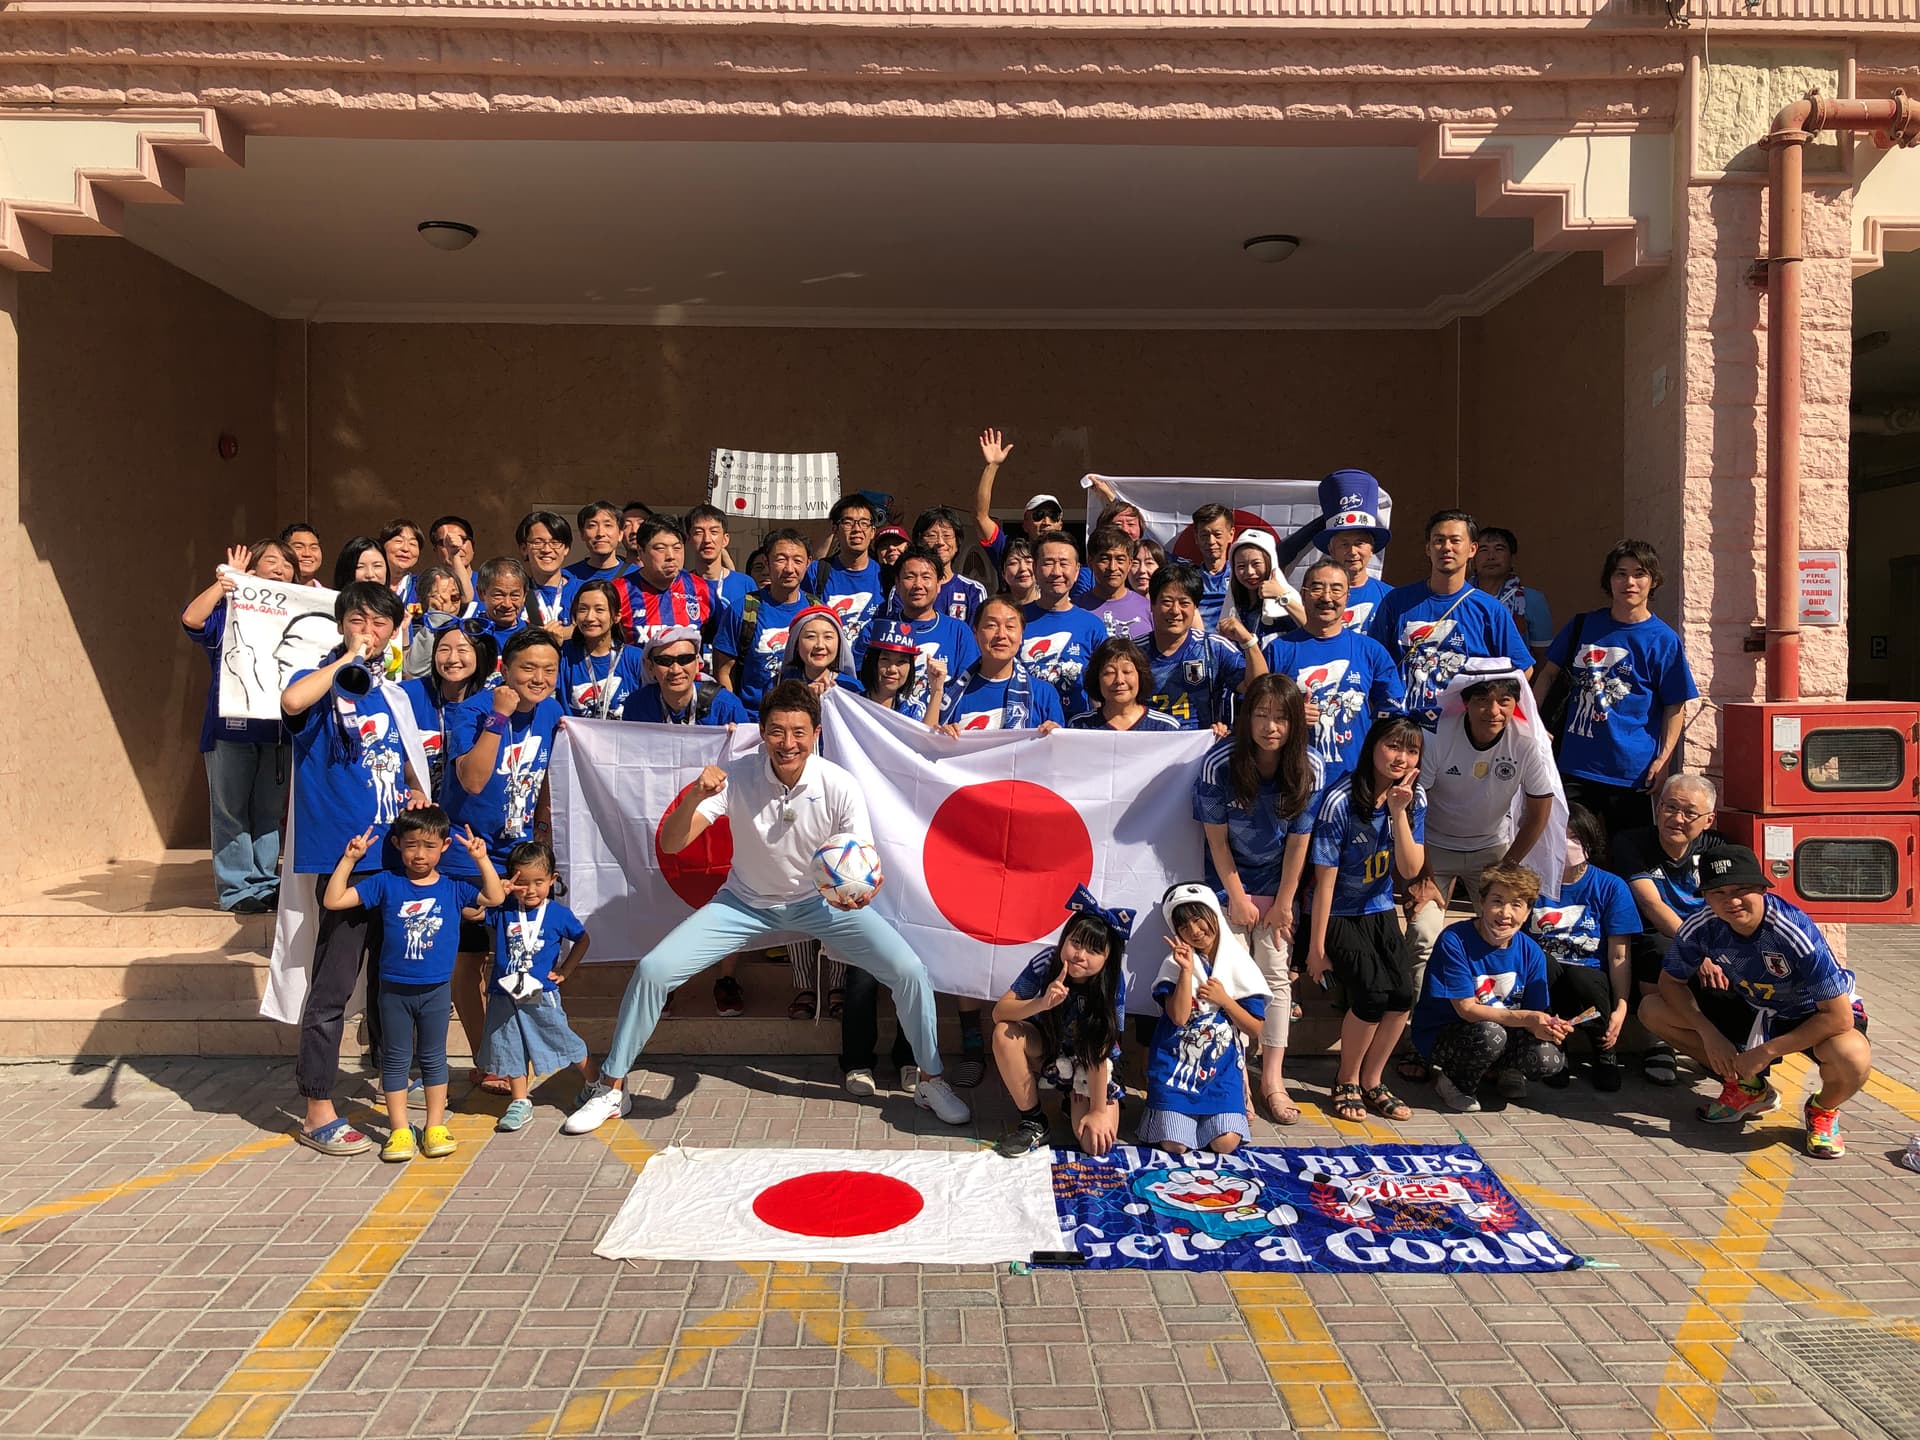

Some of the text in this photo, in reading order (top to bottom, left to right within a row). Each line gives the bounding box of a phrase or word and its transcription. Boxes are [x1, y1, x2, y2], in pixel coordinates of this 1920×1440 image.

[736, 461, 743, 469] is
[750, 462, 775, 472] simple
[718, 470, 728, 479] 22
[730, 473, 746, 481] men
[747, 474, 769, 483] chase
[776, 475, 789, 484] ball
[803, 475, 814, 484] 90
[738, 484, 751, 493] the
[761, 501, 829, 512] sometimes WIN
[232, 586, 287, 610] 2022
[1801, 589, 1833, 597] PARKING
[1808, 598, 1826, 606] ONLY
[888, 621, 897, 634] I
[879, 632, 914, 648] JAPAN
[1872, 637, 1886, 657] P
[1152, 691, 1190, 720] 24
[1363, 850, 1390, 884] 10
[1710, 859, 1733, 870] TOKYO
[1117, 1145, 1290, 1174] JAPAN
[1297, 1153, 1485, 1176] BLUES
[1354, 1180, 1450, 1202] 2022
[1062, 1223, 1200, 1262] Get
[1253, 1235, 1313, 1263] a
[1325, 1226, 1575, 1265] Goal!!
